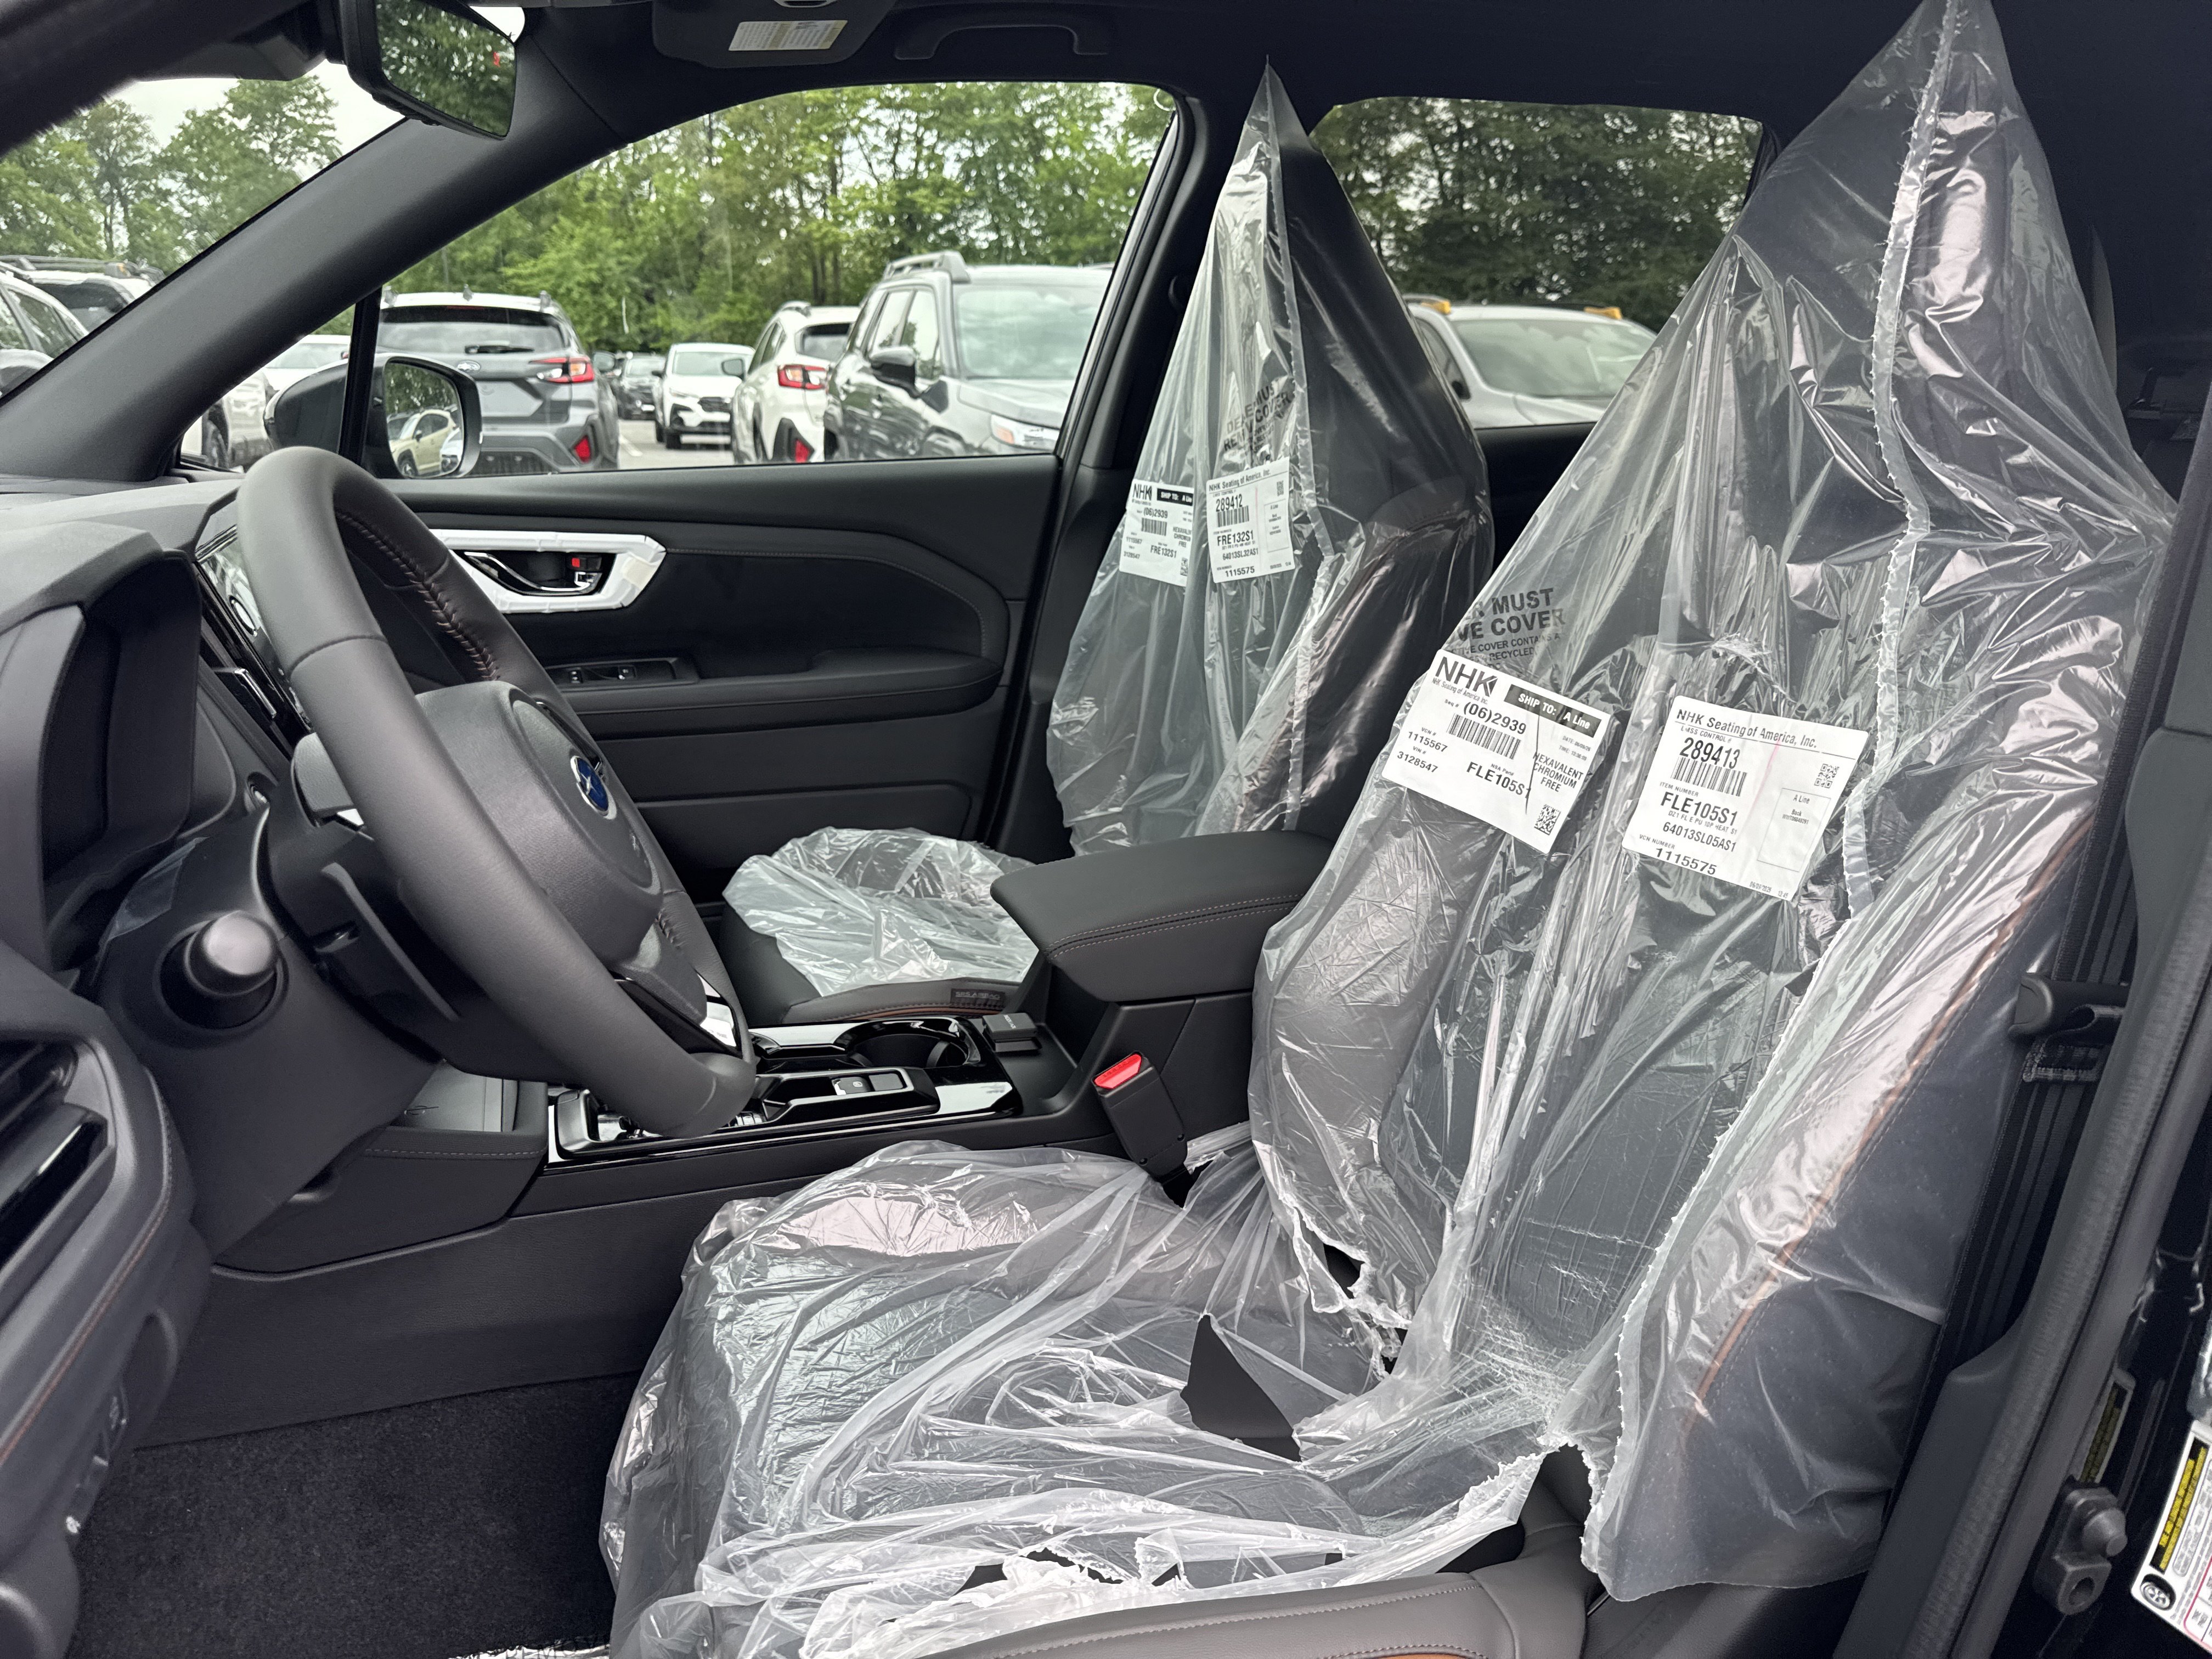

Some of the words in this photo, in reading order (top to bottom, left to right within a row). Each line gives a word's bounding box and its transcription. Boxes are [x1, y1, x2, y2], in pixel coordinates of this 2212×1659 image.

[1132, 483, 1152, 501] NHK
[1209, 483, 1221, 492] NHK
[1222, 479, 1239, 489] Seating
[1216, 494, 1242, 512] 289412
[1144, 507, 1167, 518] (06)2939
[1217, 530, 1254, 546] FRE132S1
[1150, 545, 1177, 558] FRE132S1
[1222, 548, 1259, 561] 64013SL32AS1
[1225, 566, 1255, 577] 1115575
[1491, 588, 1553, 615] MUST
[1491, 608, 1565, 636] COVER
[1478, 640, 1509, 652] COVER
[1435, 656, 1497, 697] NHK
[1463, 690, 1480, 701] America
[1464, 702, 1526, 734] (06)2939
[1518, 693, 1541, 708] SHIP
[1543, 702, 1556, 715] TO:
[1563, 712, 1571, 722] A
[1573, 715, 1590, 729] Line
[1677, 709, 1705, 725] NHK
[1707, 717, 1748, 737] Seating
[1747, 726, 1757, 736] of
[1760, 727, 1797, 747] America,
[1800, 735, 1817, 748] Inc.
[1700, 730, 1726, 742] CONTROL
[1408, 731, 1448, 752] 1115567
[1397, 751, 1438, 772] 3128547
[1679, 737, 1741, 769] 289413
[1533, 752, 1584, 780] HEXAVALENT
[1466, 761, 1531, 798] FLE105S1
[1533, 763, 1577, 788] CHROMIUM
[1541, 777, 1561, 792] FREE
[1660, 781, 1674, 790] ITEM
[1674, 786, 1699, 797] NUMBER
[1660, 791, 1738, 826] FLE105S1
[1798, 795, 1810, 804] Line
[1663, 822, 1736, 852] 64013SL05AS1
[1715, 824, 1729, 833] HEAT
[1651, 837, 1675, 850] NUMBER
[1656, 848, 1717, 875] 1115575
